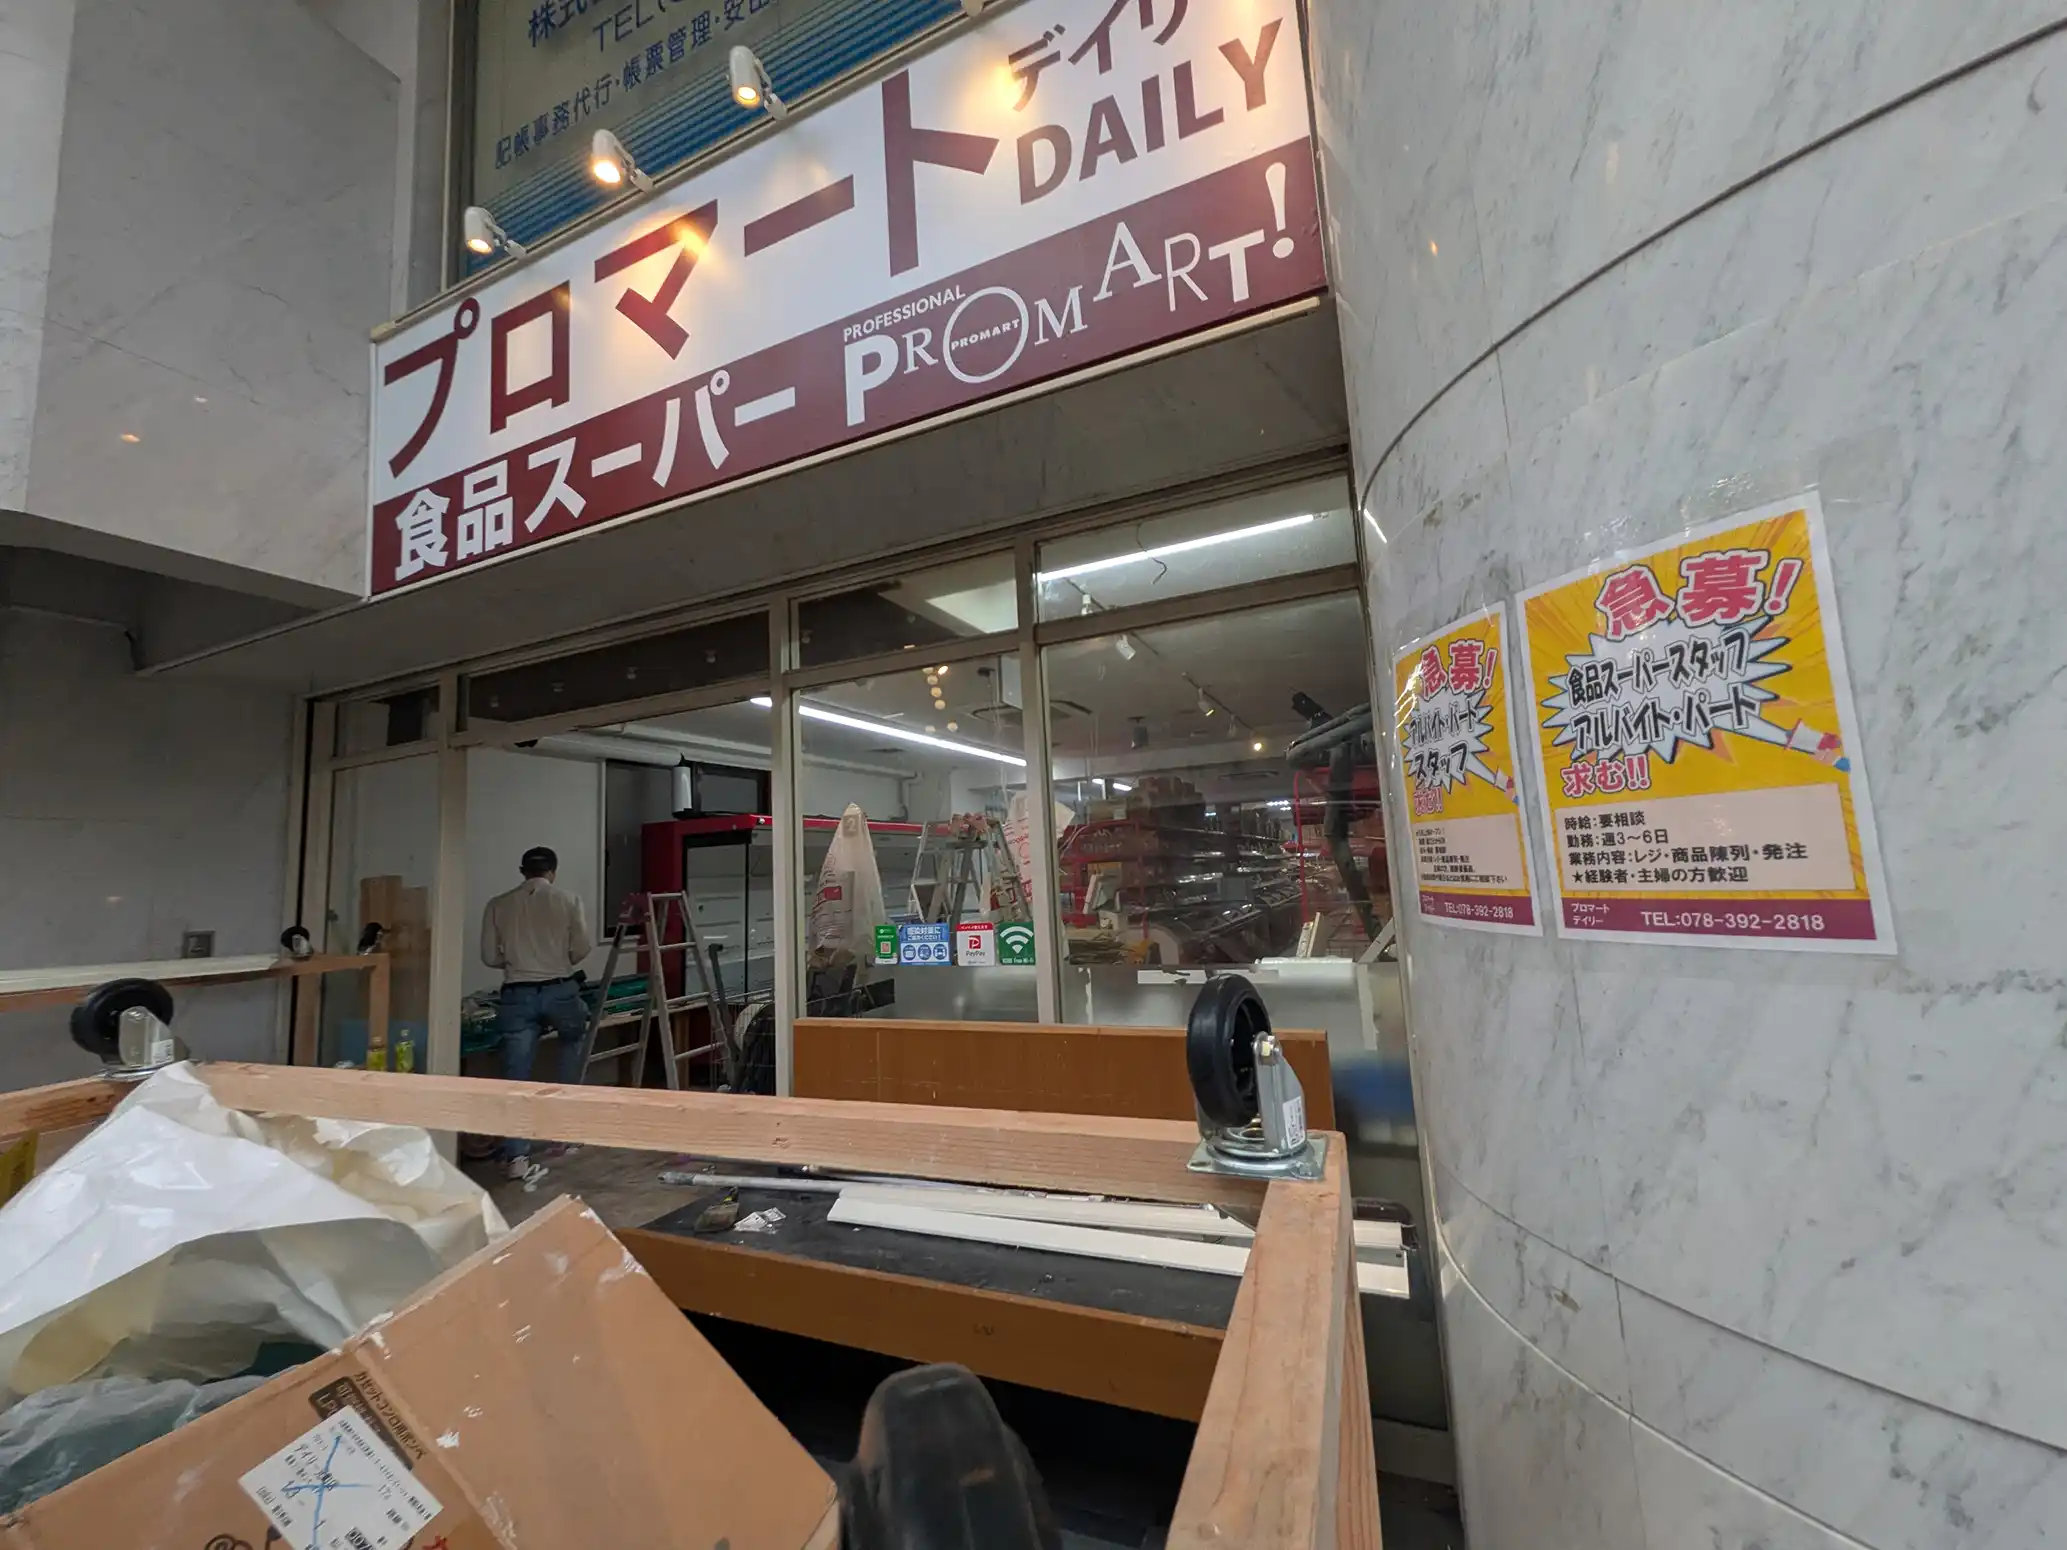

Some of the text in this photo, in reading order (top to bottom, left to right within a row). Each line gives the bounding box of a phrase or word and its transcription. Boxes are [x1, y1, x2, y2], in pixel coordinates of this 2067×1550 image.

[1015, 17, 1284, 206] DAILY
[384, 69, 1000, 479] プロマート
[843, 284, 966, 342] PROFESSIONAL
[951, 318, 1020, 351] PROMART
[395, 369, 796, 583] 食品スーパー
[1595, 549, 1802, 640] 急募!
[1567, 628, 1748, 706] 食品スーパースタッフ
[1573, 686, 1759, 751] アルバイト・パート
[1412, 741, 1470, 780] スタッフ
[1564, 810, 1647, 830] 時給：要相談
[1640, 910, 1826, 932] TEL:078-392-2818
